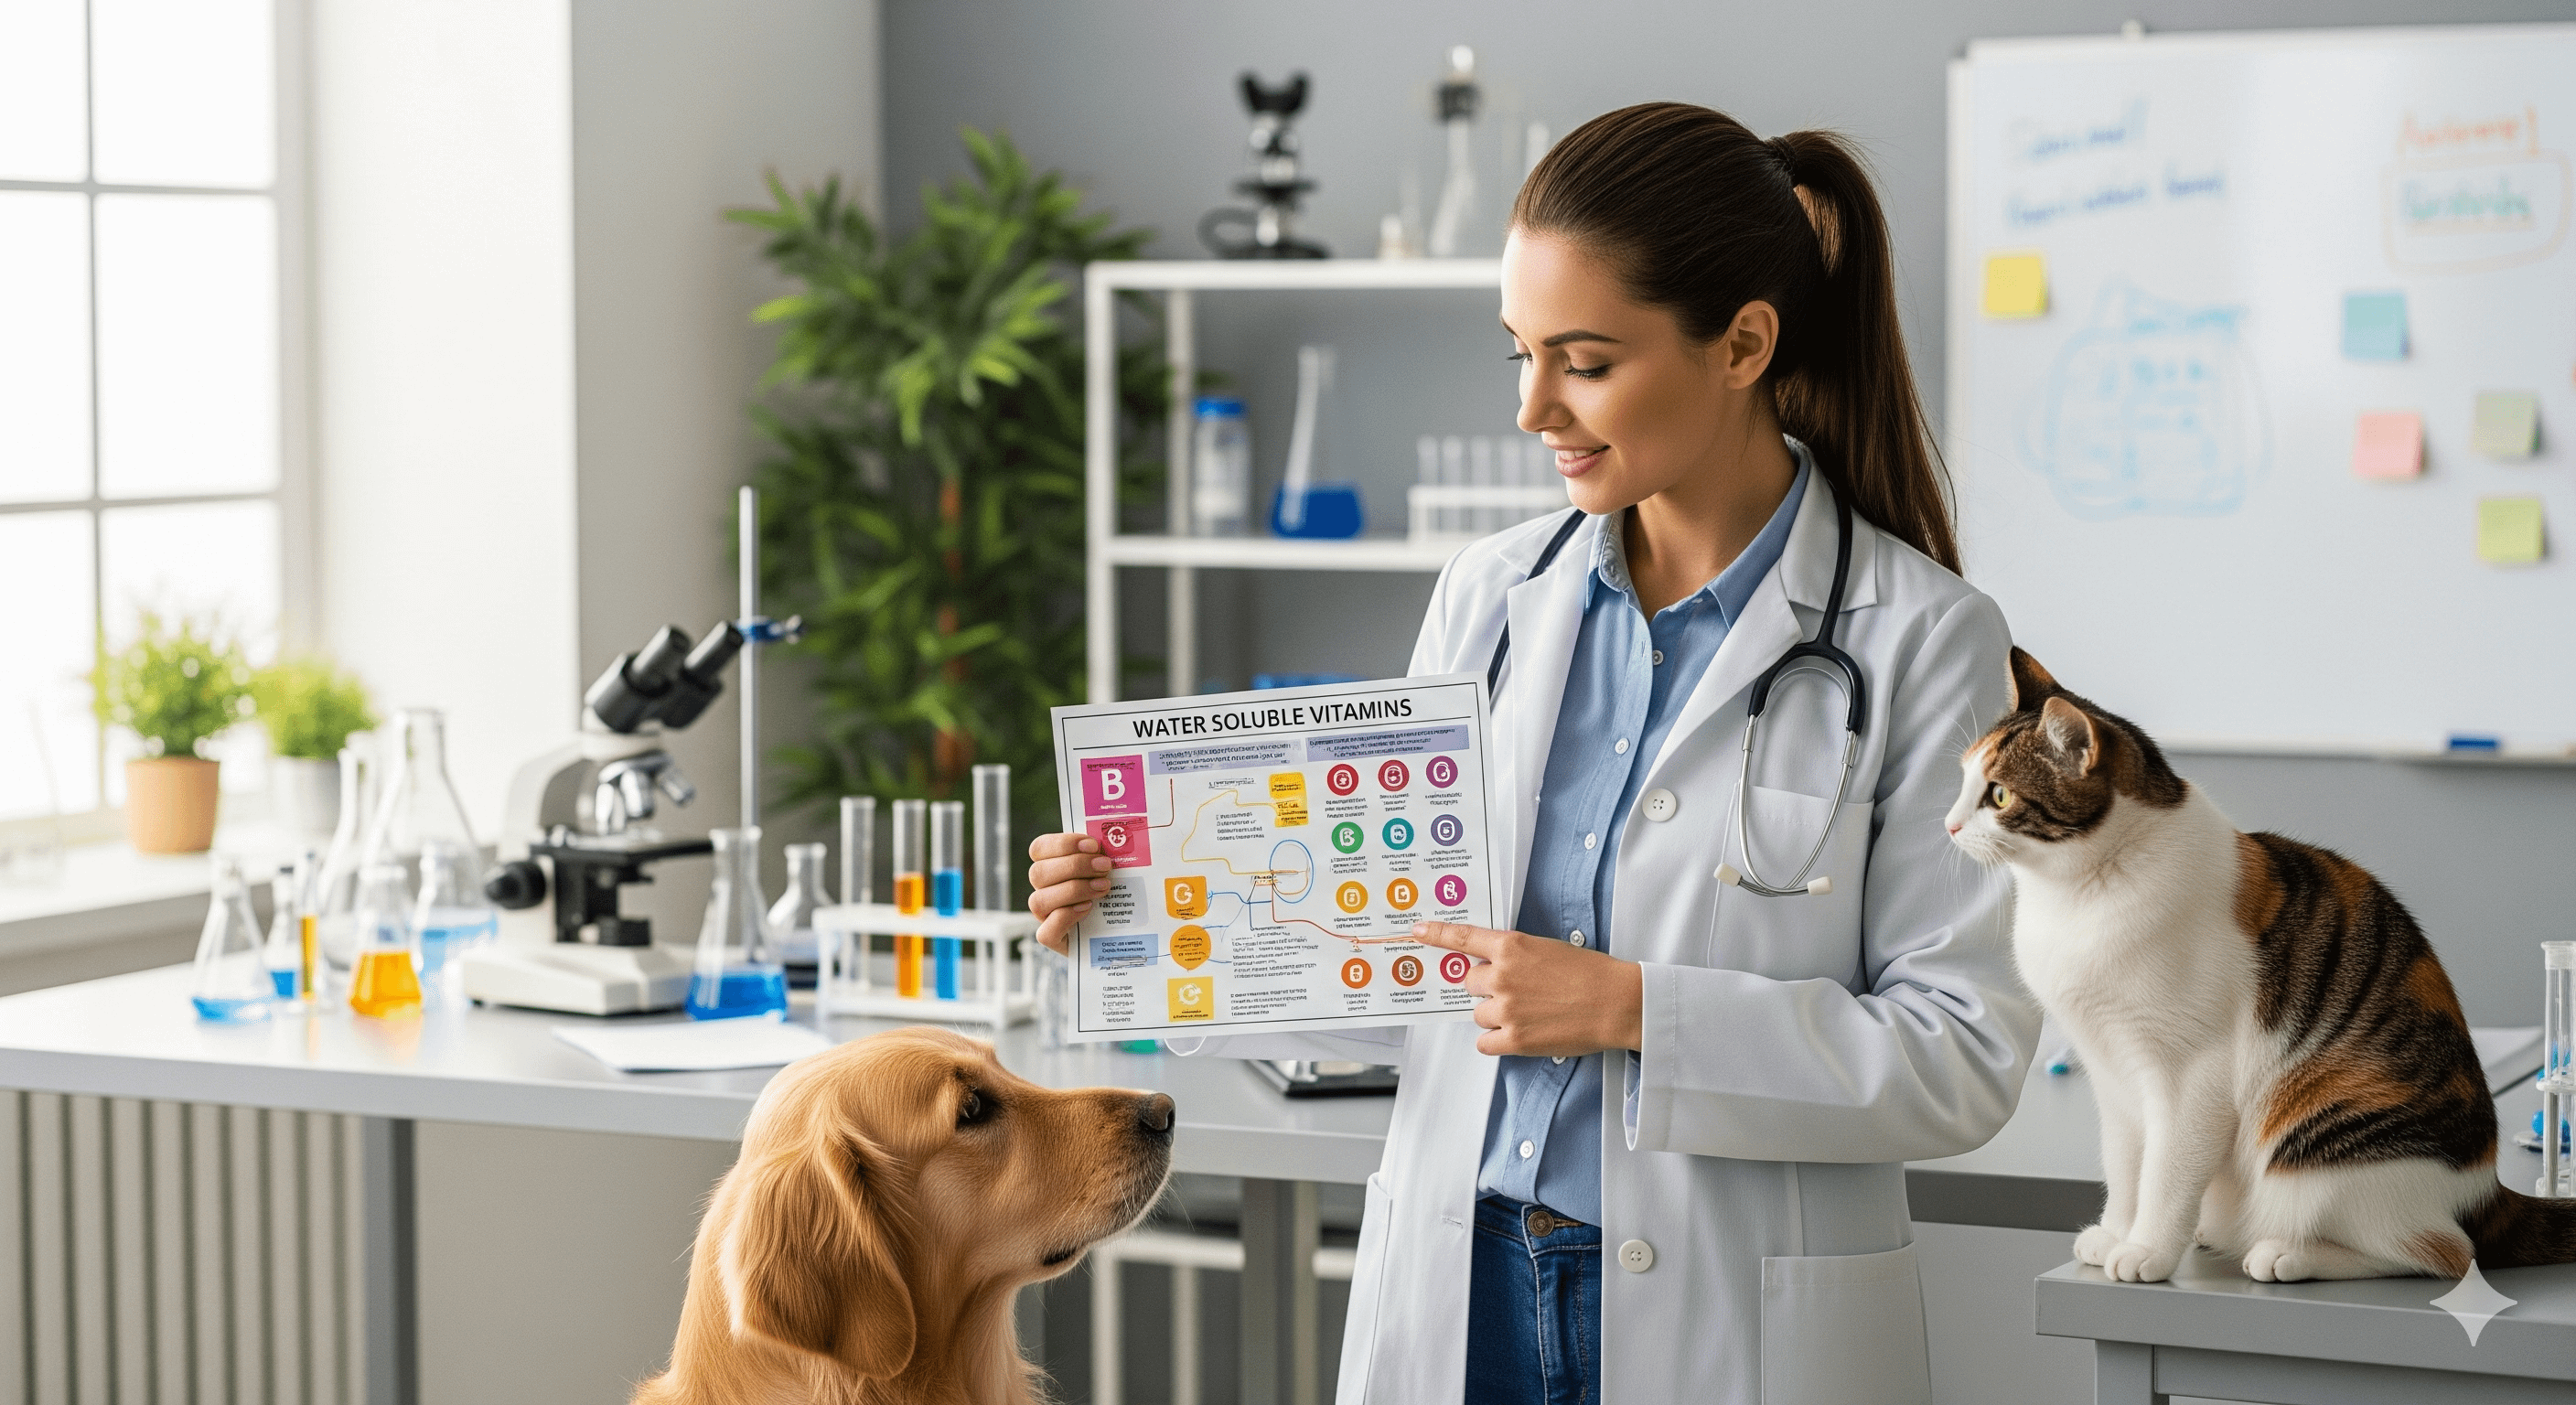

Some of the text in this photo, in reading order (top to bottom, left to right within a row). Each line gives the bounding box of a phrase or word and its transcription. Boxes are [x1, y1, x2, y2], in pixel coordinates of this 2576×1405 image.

[1133, 698, 1412, 738] WATER SOLUBLE VITAMINS
[1101, 768, 1125, 800] B
